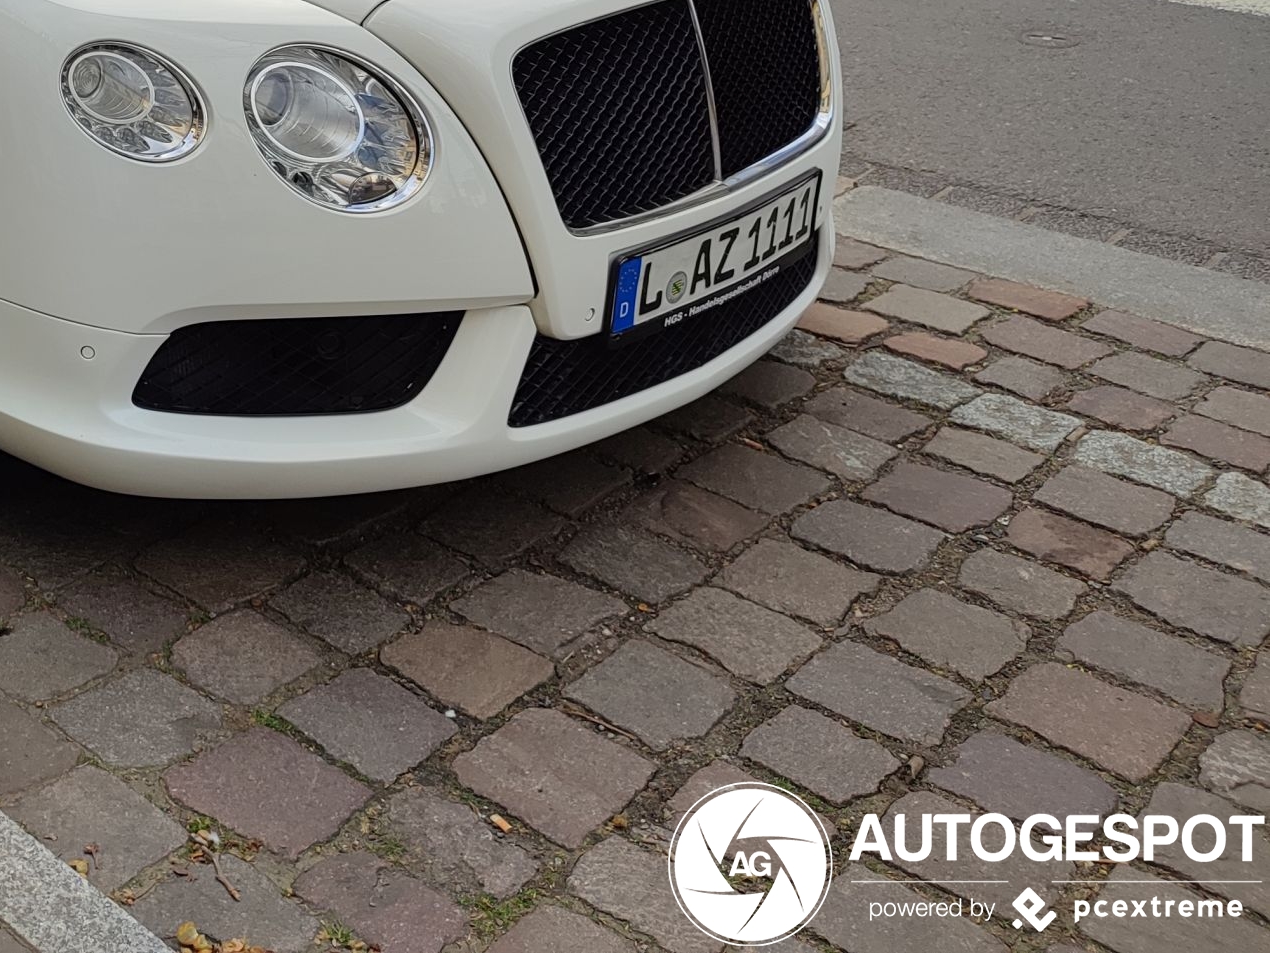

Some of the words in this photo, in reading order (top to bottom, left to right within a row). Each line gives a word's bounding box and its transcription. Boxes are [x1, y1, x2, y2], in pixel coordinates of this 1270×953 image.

[639, 262, 663, 316] L
[619, 302, 629, 318] D
[664, 311, 683, 327] HGS
